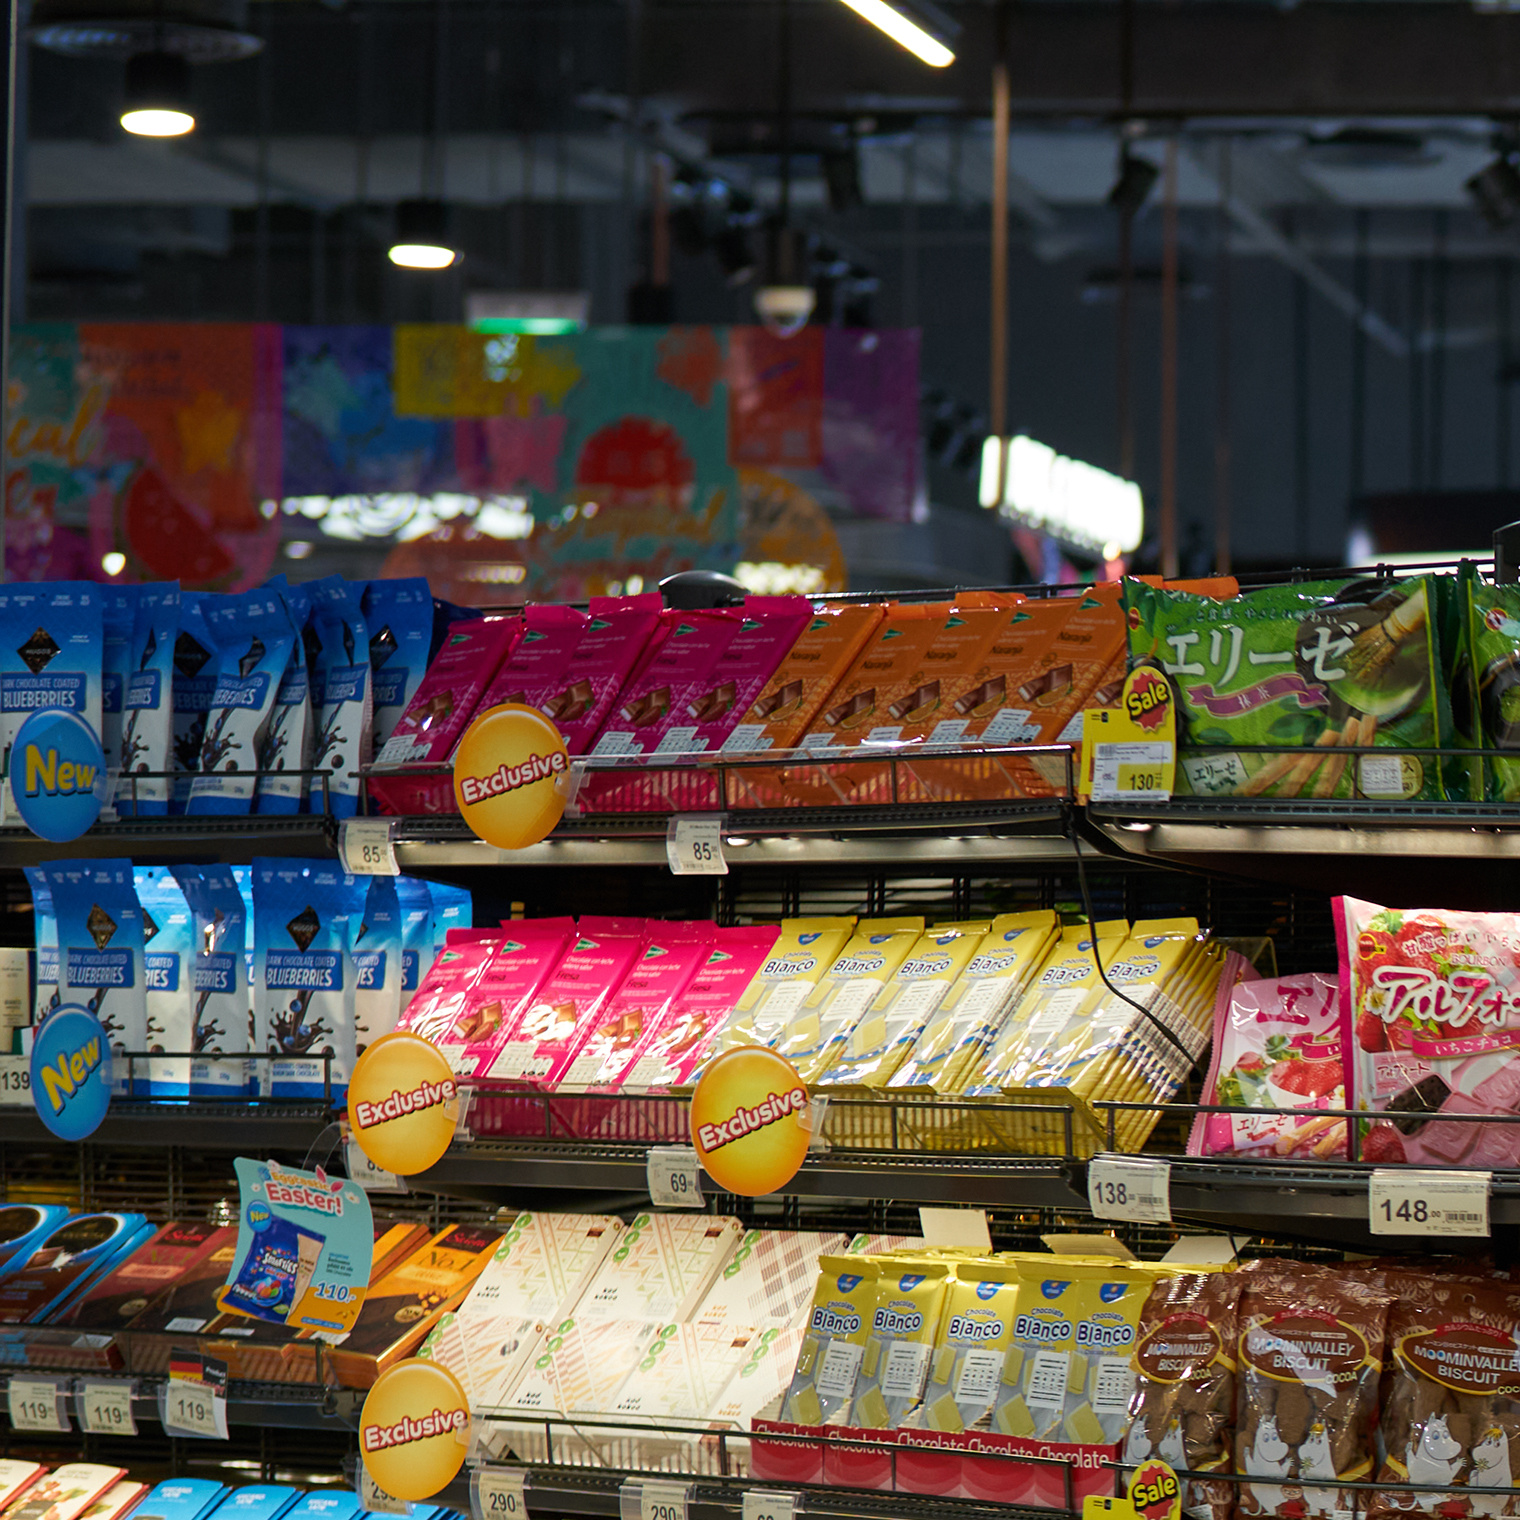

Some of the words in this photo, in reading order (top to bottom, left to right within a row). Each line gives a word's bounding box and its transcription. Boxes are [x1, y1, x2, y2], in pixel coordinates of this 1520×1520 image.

[1162, 622, 1360, 688] エリーゼ
[1126, 679, 1170, 720] Sale
[24, 742, 97, 797] New
[460, 749, 568, 807] Exclusive
[66, 966, 126, 986] BLUEBERRIES
[266, 966, 334, 987] BLUEBERRIES
[966, 953, 1018, 976] Blanco
[1434, 1035, 1513, 1057] いちごチョコ
[1, 1071, 30, 1091] 139
[39, 1035, 101, 1119] New
[355, 1078, 457, 1130] Exclusive
[698, 1084, 807, 1154] Exclusive
[264, 1181, 344, 1217] Easter!
[811, 1307, 860, 1332] Blanco
[873, 1306, 922, 1331] Blanco
[964, 1307, 996, 1318] Chocolate
[948, 1317, 1003, 1340] Blanco
[1014, 1315, 1071, 1339] Blanco
[1076, 1321, 1133, 1345] Blanco
[1252, 1337, 1356, 1358] MOOMINVALLEY
[1272, 1353, 1330, 1372] BISCUIT
[1437, 1363, 1501, 1385] BISCUIT
[19, 1401, 49, 1420] 119
[94, 1405, 123, 1424] 119
[364, 1408, 467, 1452] Exclusive
[1038, 1446, 1109, 1470] Chocolate
[1132, 1474, 1178, 1507] Sale
